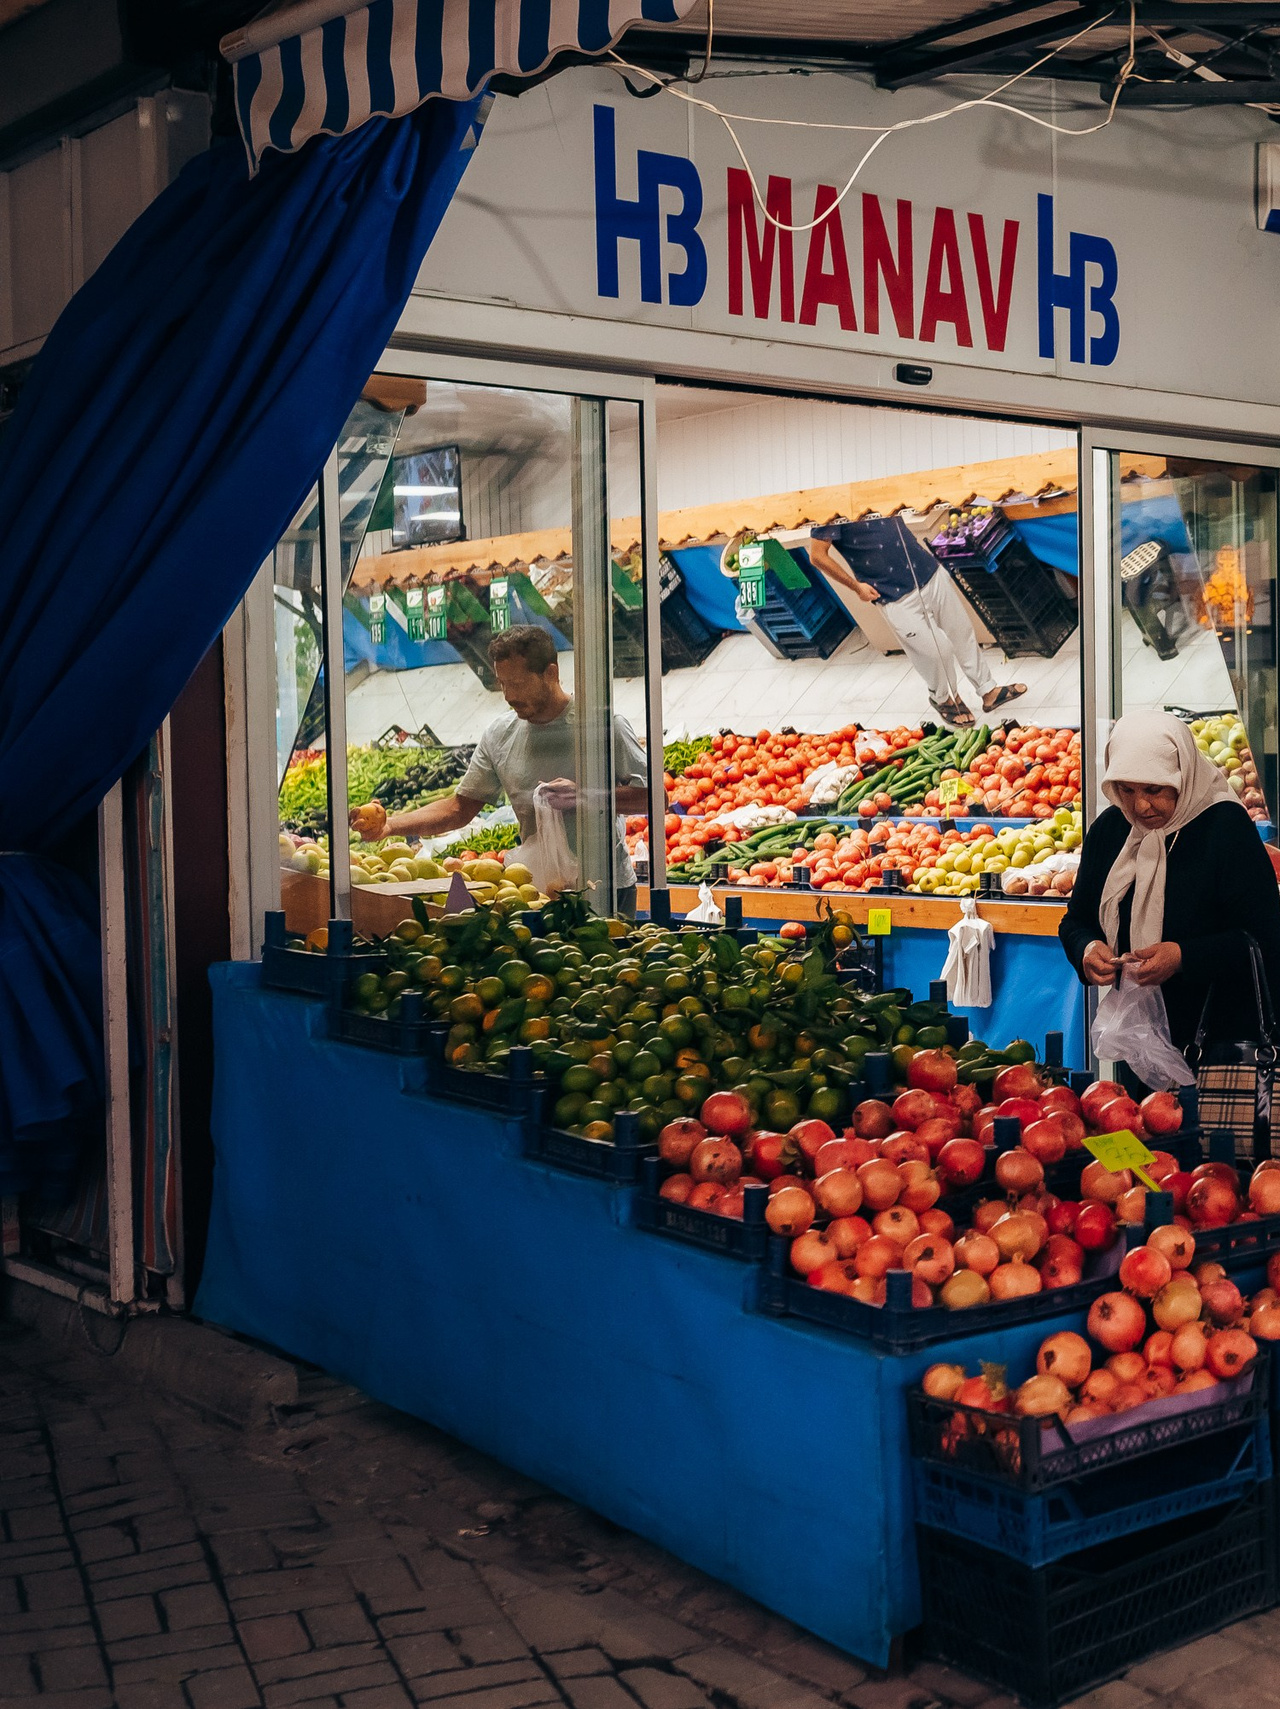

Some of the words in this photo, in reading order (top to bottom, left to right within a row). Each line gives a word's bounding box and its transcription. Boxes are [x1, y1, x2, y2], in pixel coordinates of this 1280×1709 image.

[593, 104, 708, 307] HB
[726, 166, 1020, 352] MANAV
[1037, 193, 1120, 367] HB
